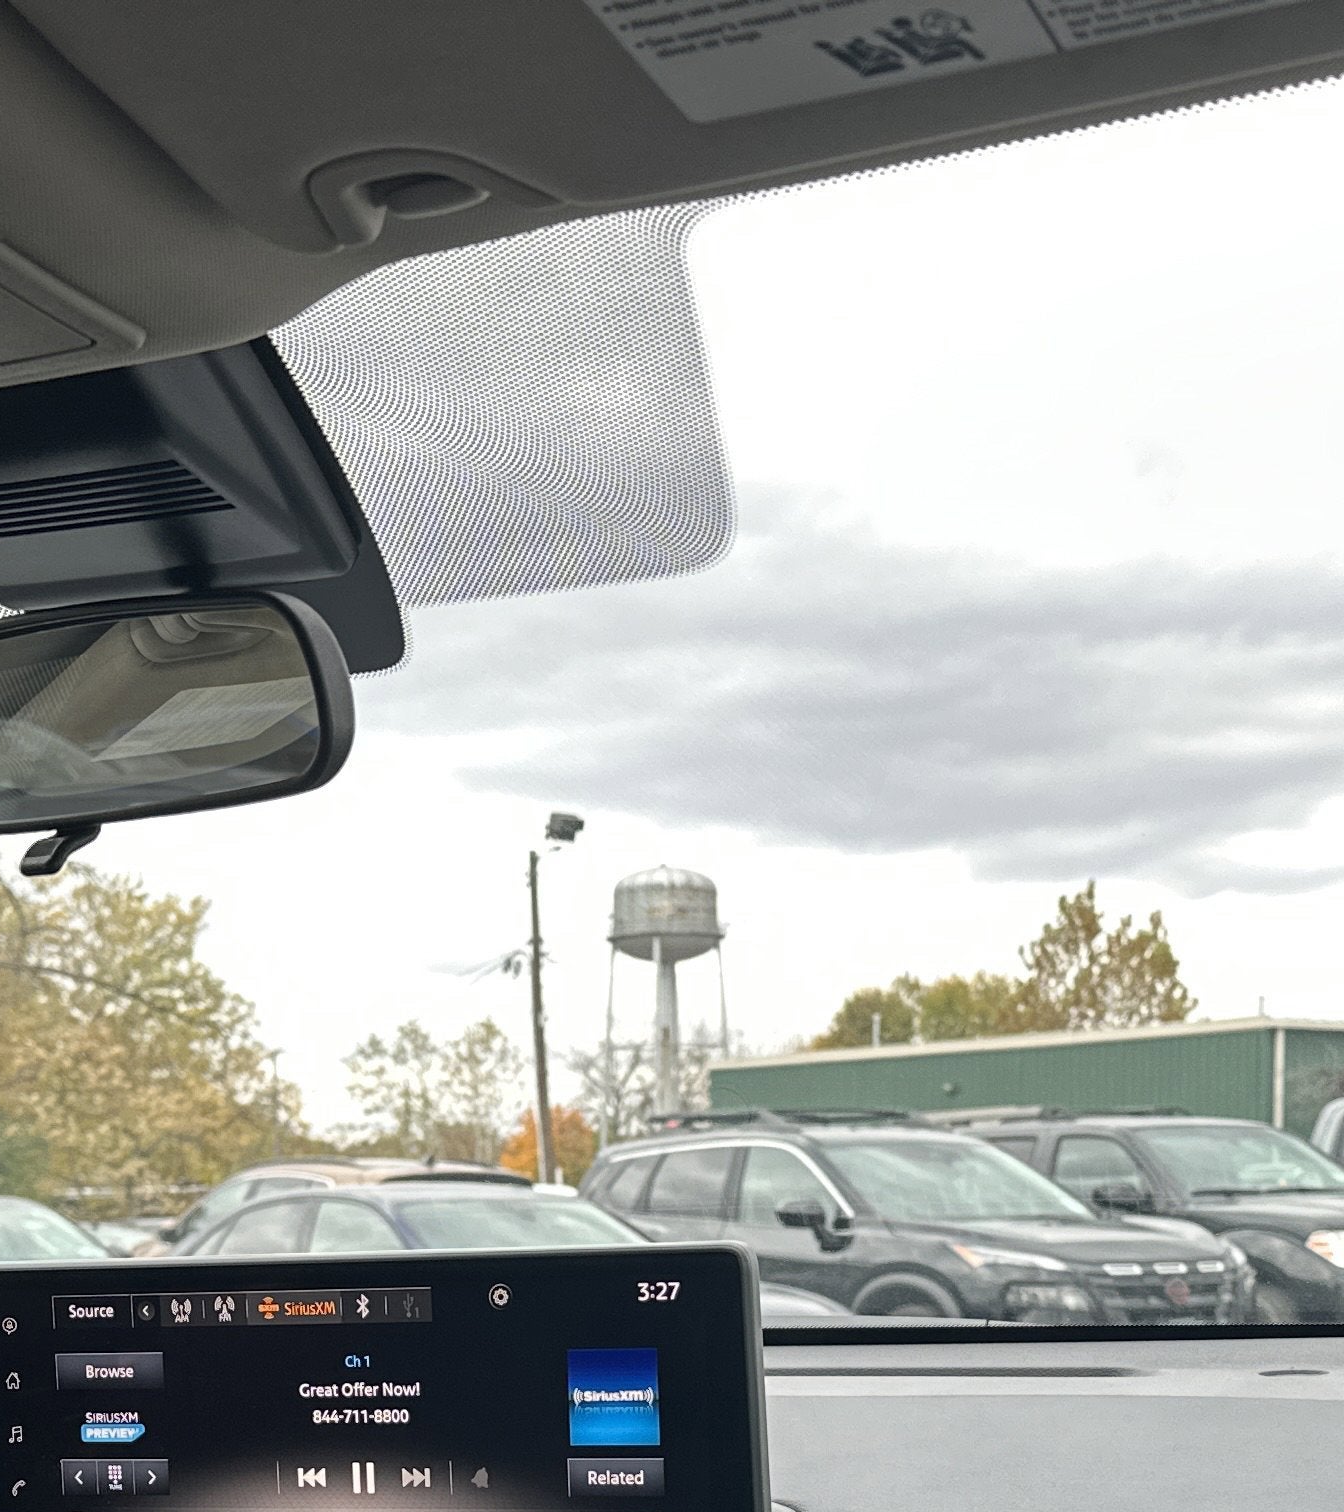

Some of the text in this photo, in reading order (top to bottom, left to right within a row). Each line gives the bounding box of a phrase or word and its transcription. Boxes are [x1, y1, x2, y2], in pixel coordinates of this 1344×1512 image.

[637, 1281, 680, 1301] 3:27
[68, 1304, 115, 1319] Source
[284, 1301, 336, 1317] SiriusXM
[345, 1355, 370, 1368] Ch 1
[85, 1365, 134, 1379] Browse
[299, 1382, 421, 1399] Great Offer Now!
[312, 1409, 409, 1424] 844-711-8800
[85, 1427, 138, 1439] PREVIEW
[587, 1470, 644, 1486] Related
